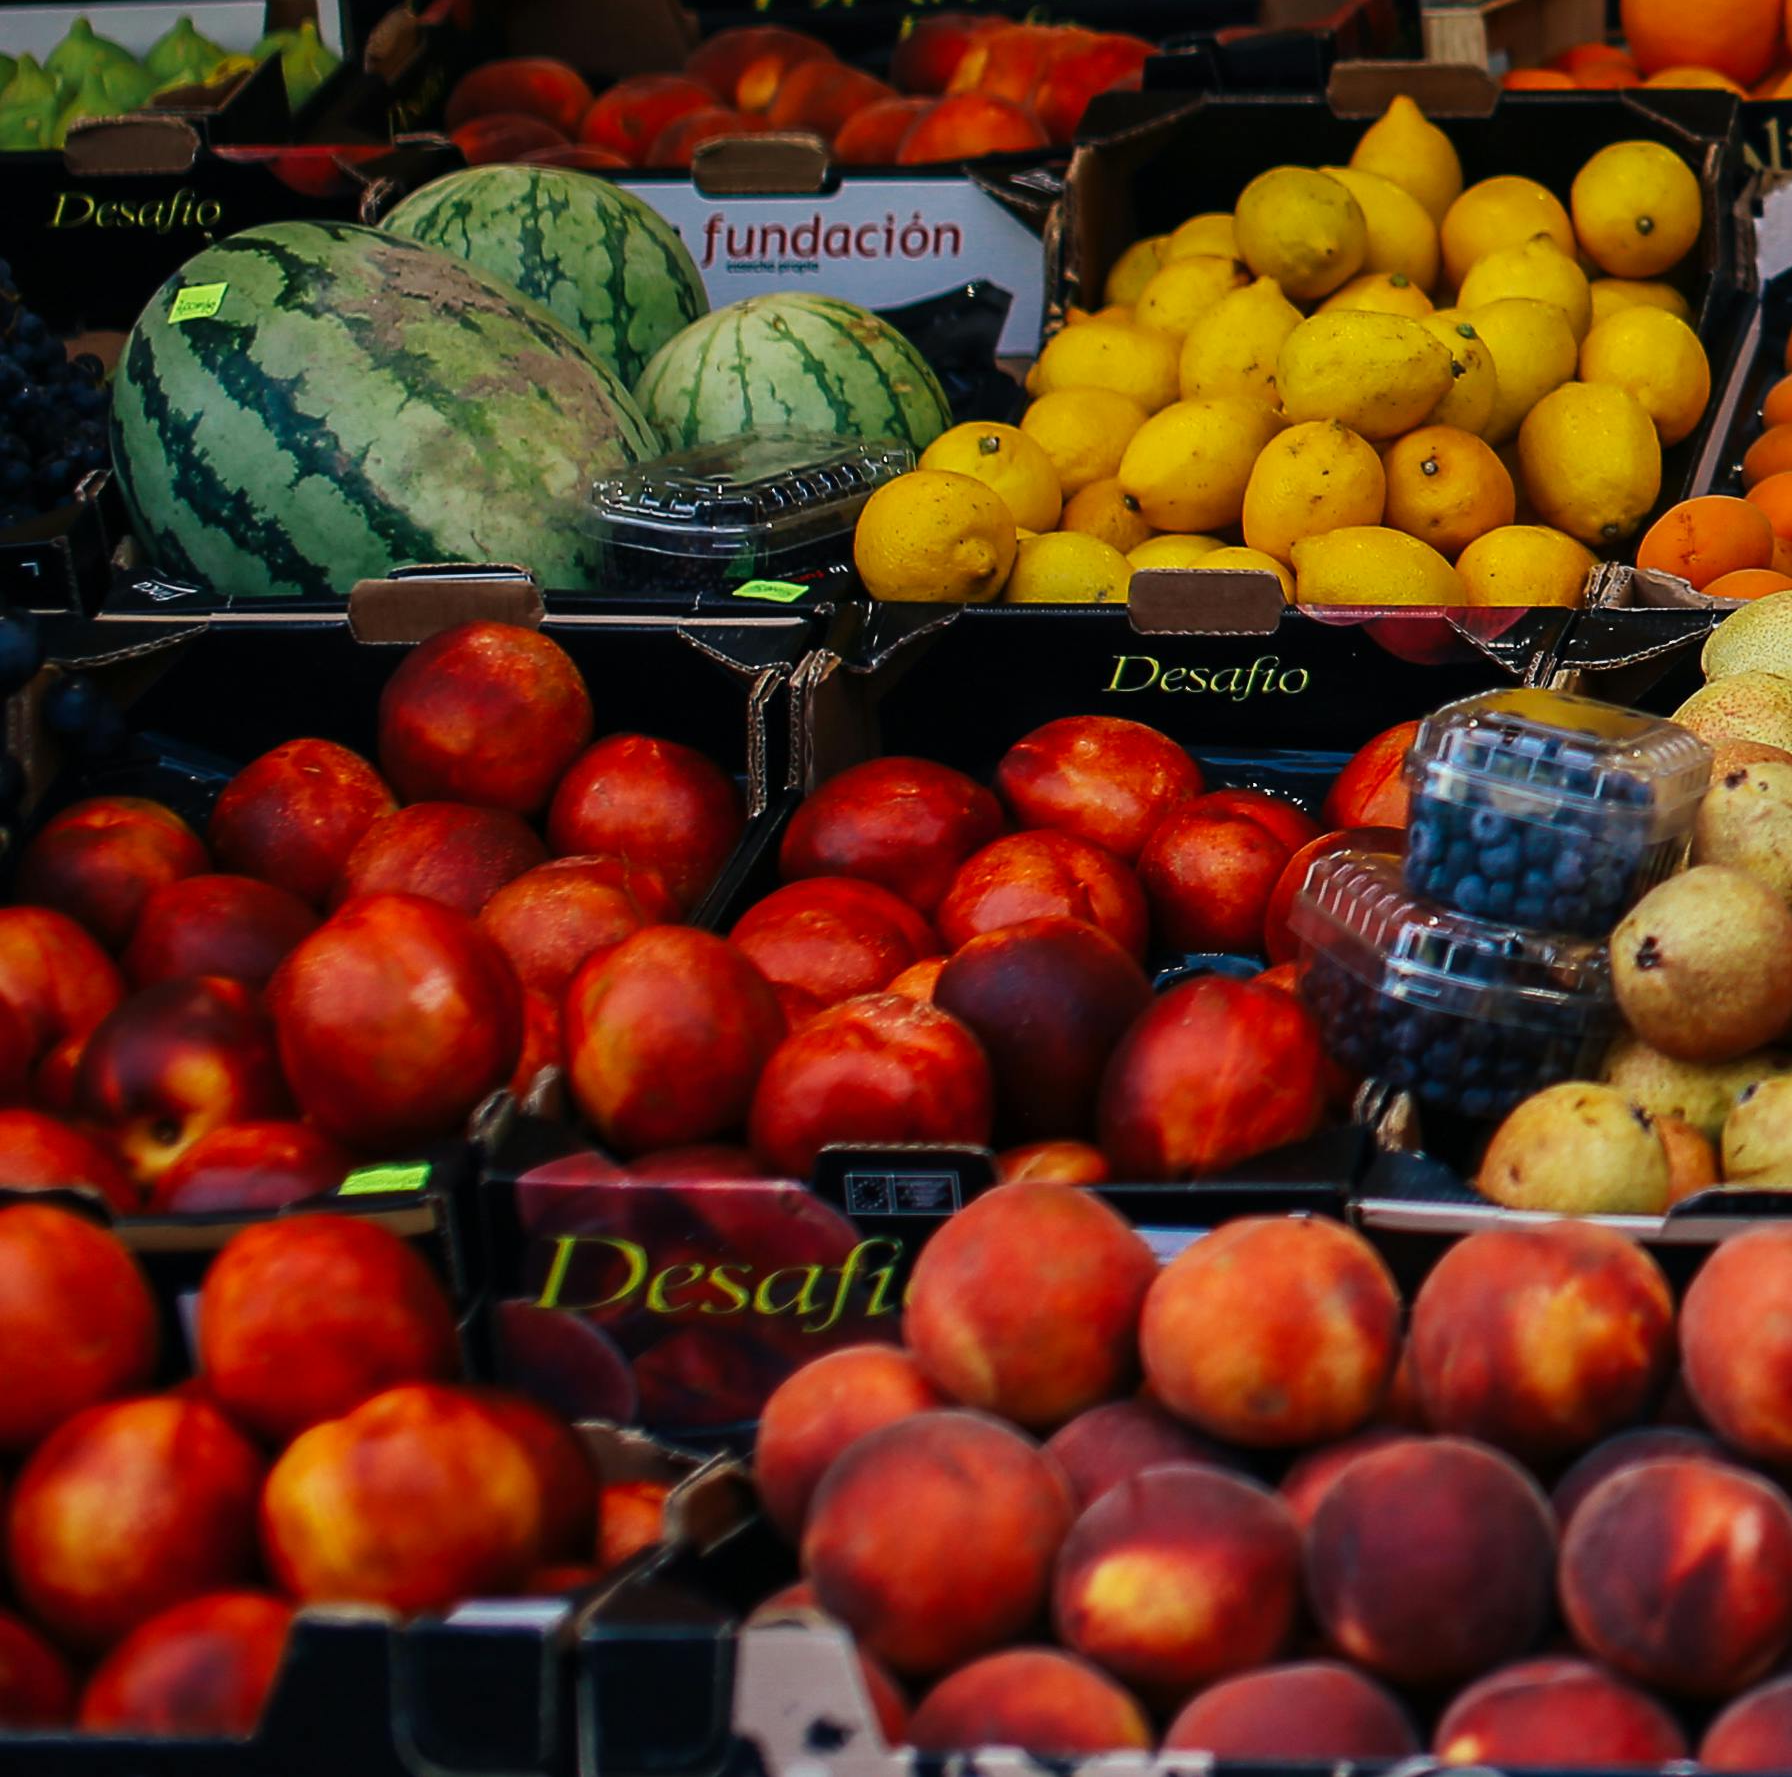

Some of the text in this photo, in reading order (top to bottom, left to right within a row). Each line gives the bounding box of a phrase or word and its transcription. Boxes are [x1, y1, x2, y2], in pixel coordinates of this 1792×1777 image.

[49, 188, 221, 234] Desafio
[702, 210, 961, 269] fundación
[1101, 655, 1309, 702] Desafio
[532, 1233, 911, 1333] Desafi
